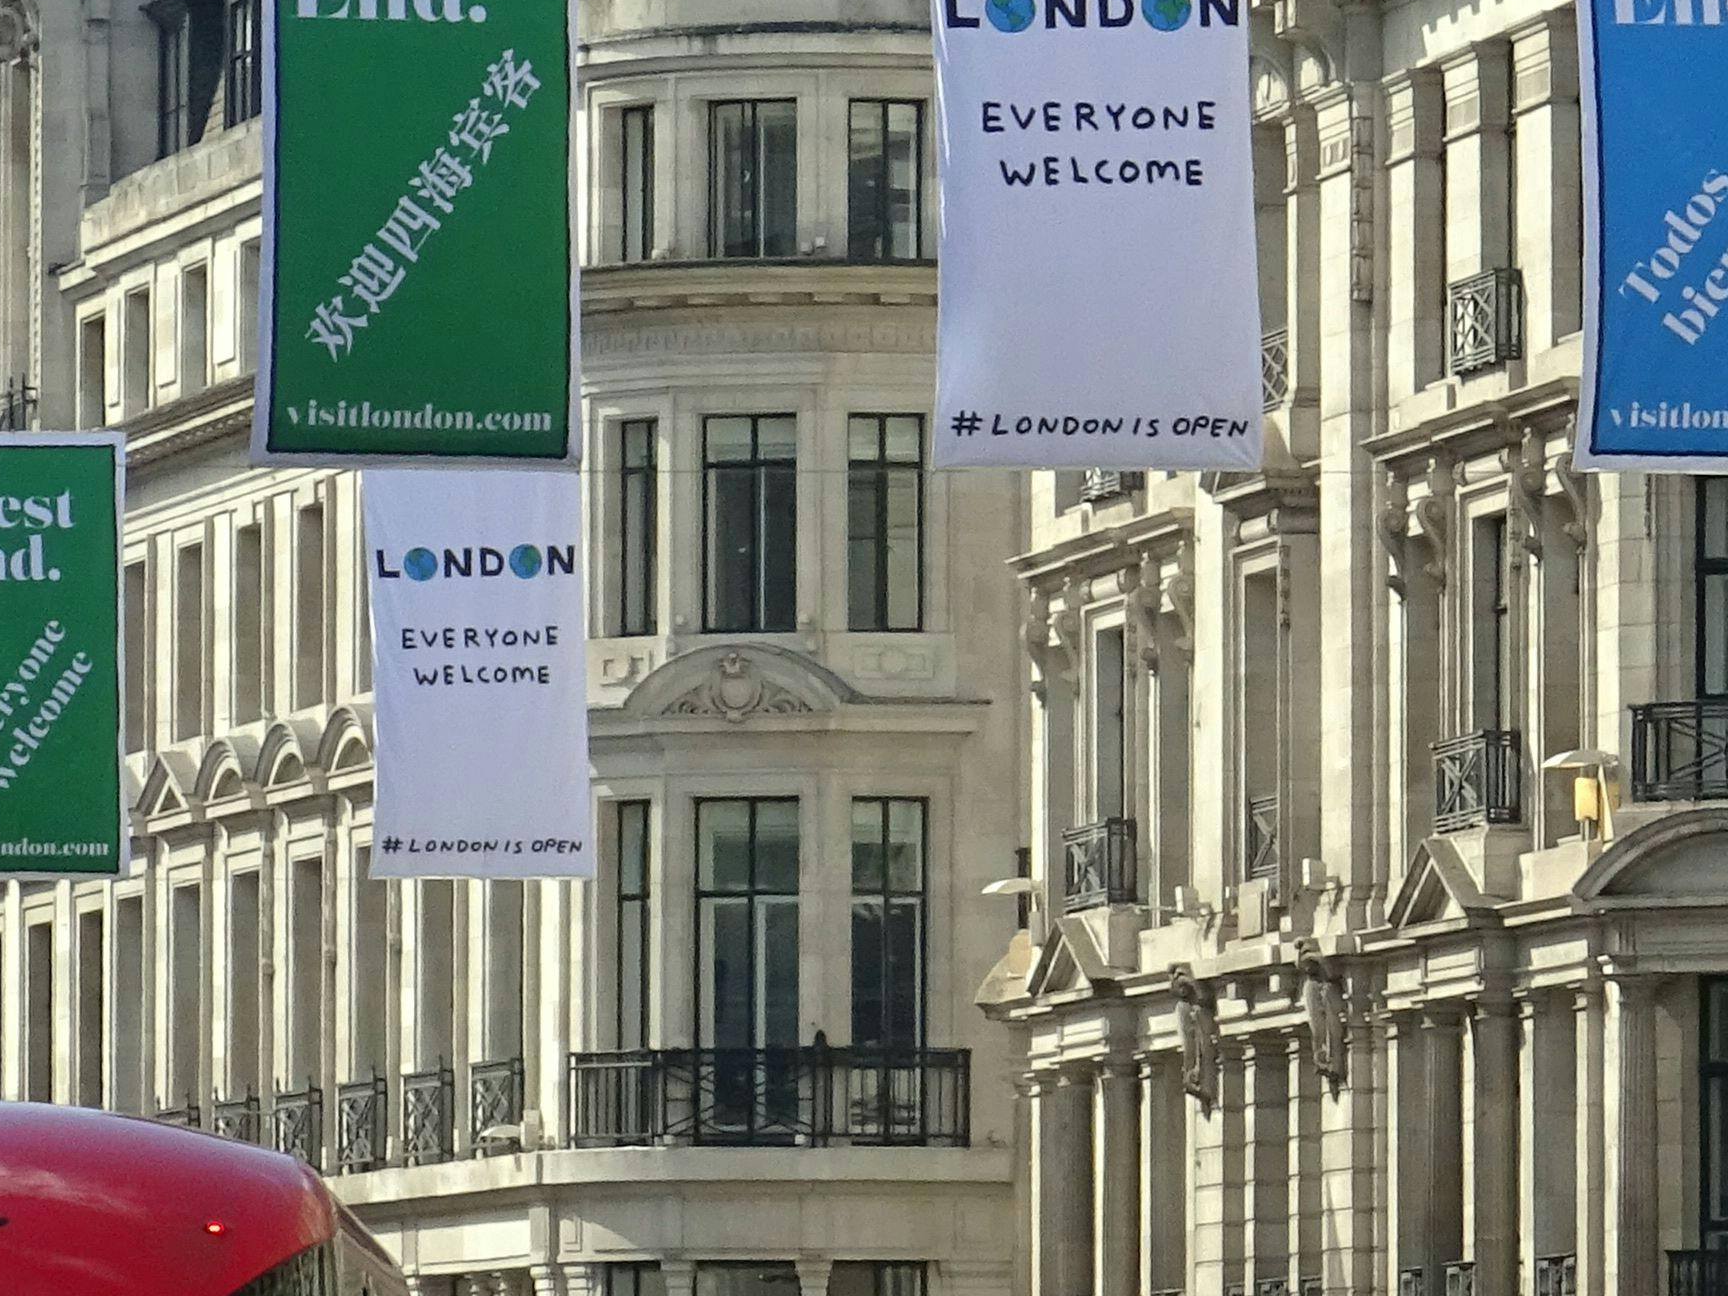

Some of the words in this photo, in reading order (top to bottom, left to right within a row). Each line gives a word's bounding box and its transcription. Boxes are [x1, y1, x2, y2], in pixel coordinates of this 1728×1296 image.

[982, 103, 1216, 134] EVERYONE
[1000, 156, 1203, 186] WELCOME
[305, 49, 541, 362] 欢迎四海宾客
[288, 401, 552, 432] visitlondon.com
[376, 543, 575, 581] LONDON
[402, 626, 559, 650] EVERYONE
[413, 665, 550, 686] WELCOME
